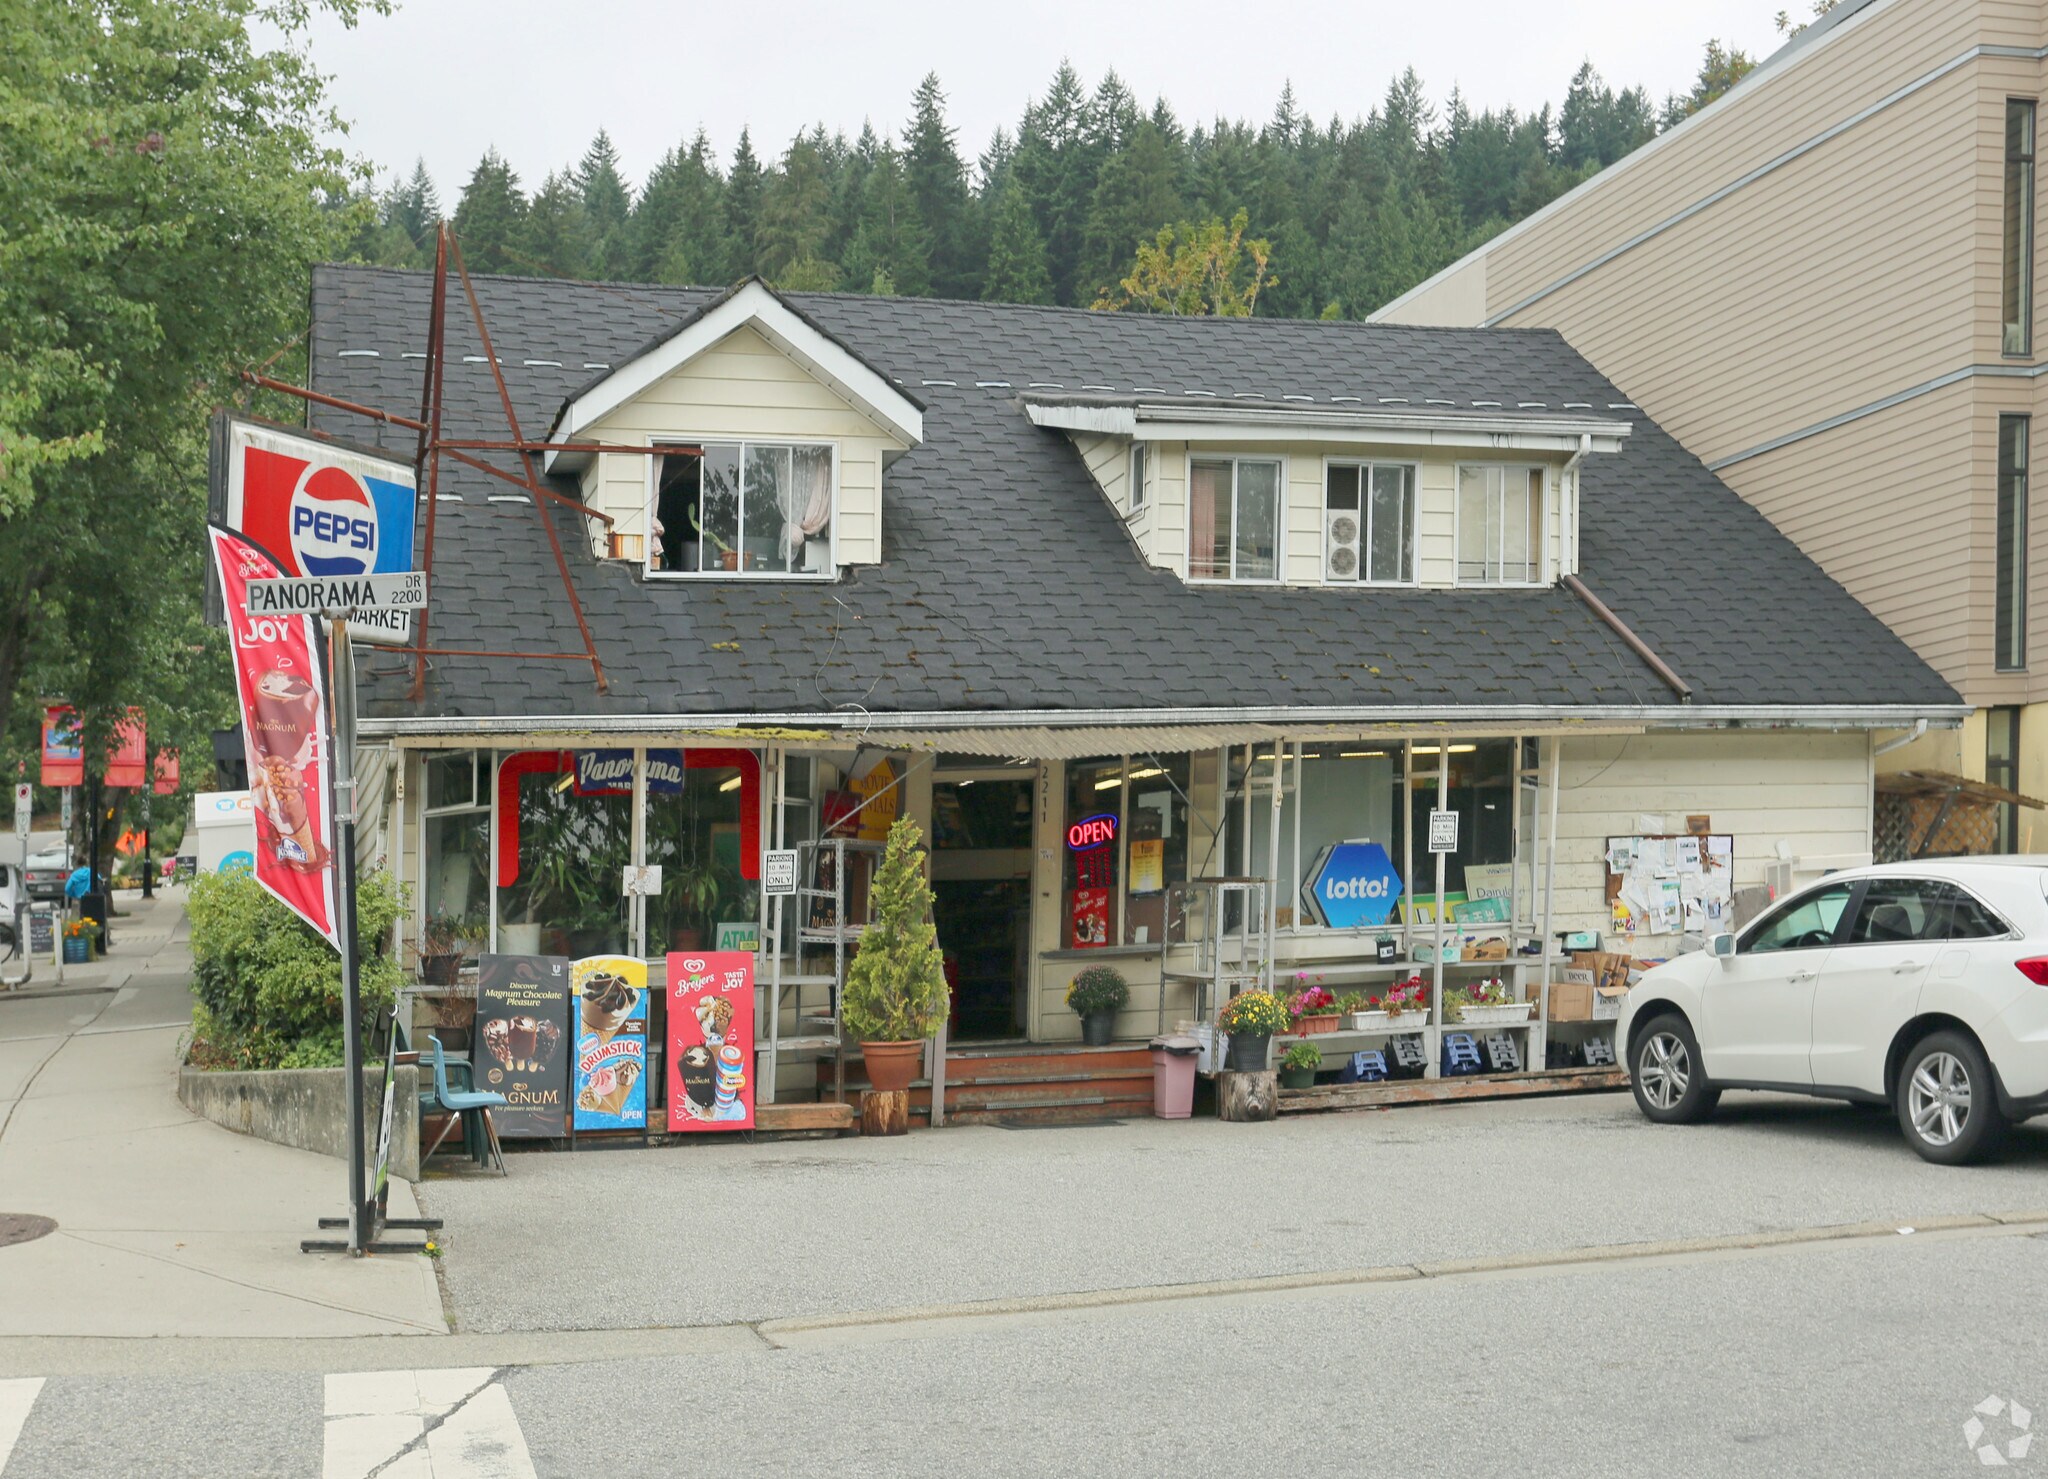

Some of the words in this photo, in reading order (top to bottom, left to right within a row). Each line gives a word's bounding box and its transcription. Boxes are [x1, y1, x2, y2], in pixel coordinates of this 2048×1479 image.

[294, 505, 375, 552] PEPSI
[405, 575, 421, 588] DR
[250, 580, 376, 611] PANORAMA
[391, 590, 422, 604] 2200
[244, 618, 289, 643] JOY
[256, 720, 297, 733] MAGNUM
[580, 752, 682, 785] Panorma
[608, 781, 651, 791] MART
[1041, 766, 1049, 823] 2211
[1069, 819, 1113, 846] OPEN
[769, 876, 791, 884] ONLY
[721, 930, 754, 949] ATM
[675, 973, 715, 997] Breyers
[725, 978, 744, 989] JOY
[485, 989, 521, 999] Magnum
[522, 991, 563, 1000] Chocolate
[506, 998, 541, 1006] Pleasure
[581, 1041, 641, 1072] DRUMSTICK
[622, 1110, 642, 1119] OPEN
